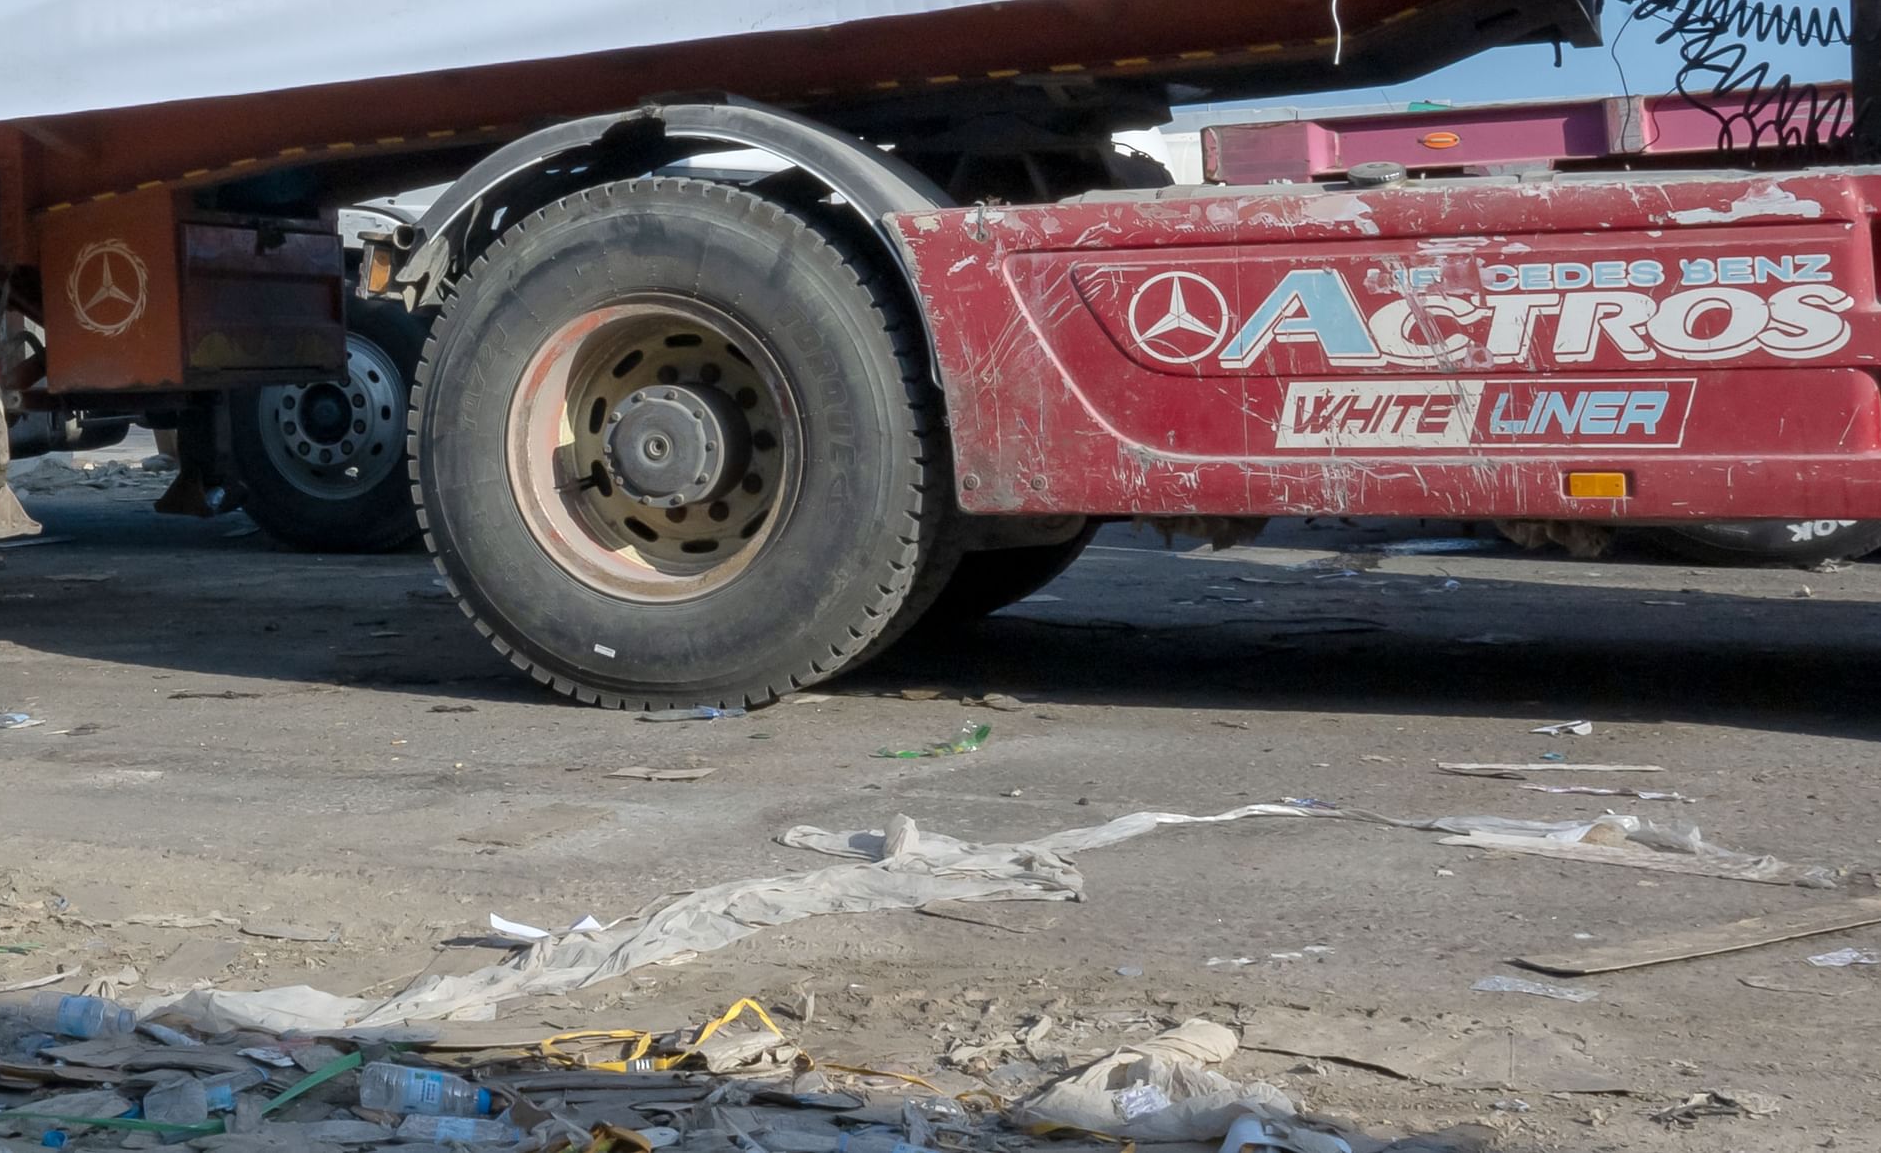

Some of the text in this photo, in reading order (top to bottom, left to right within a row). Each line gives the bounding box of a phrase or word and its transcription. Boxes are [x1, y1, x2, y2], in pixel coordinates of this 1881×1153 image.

[1681, 254, 1834, 286] BENZ
[1219, 268, 1856, 368] ACTROS
[1294, 390, 1670, 437] WHITE LINER
